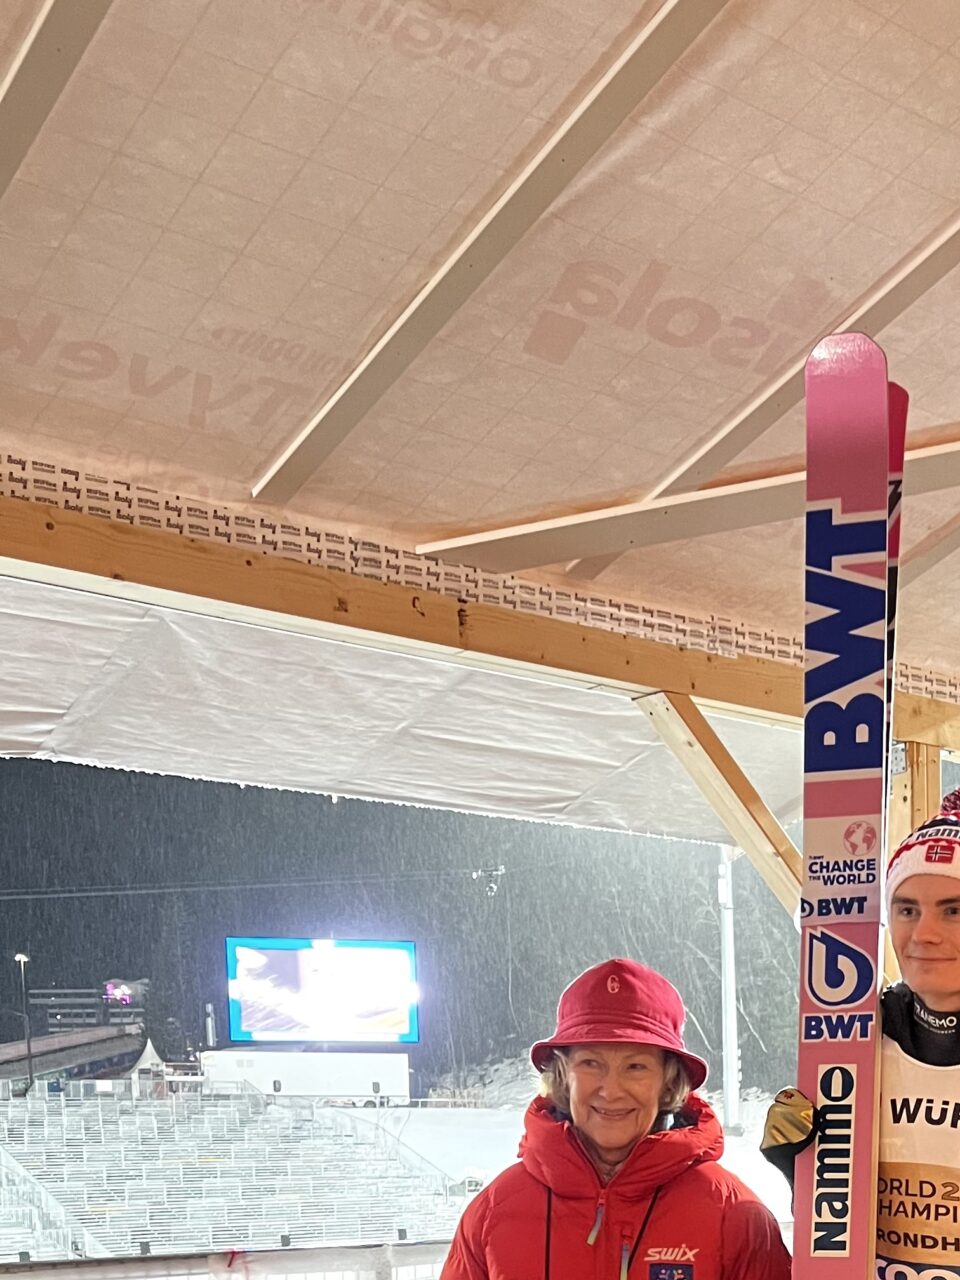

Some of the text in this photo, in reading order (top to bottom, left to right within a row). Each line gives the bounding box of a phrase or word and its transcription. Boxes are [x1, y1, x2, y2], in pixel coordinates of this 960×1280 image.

[804, 508, 887, 773] BWT
[808, 858, 876, 874] CHANGE
[822, 873, 876, 886] WORLD
[817, 896, 867, 916] BWT
[803, 1013, 873, 1040] BWT
[813, 1066, 855, 1254] Nammo
[877, 1177, 937, 1199] ORLD
